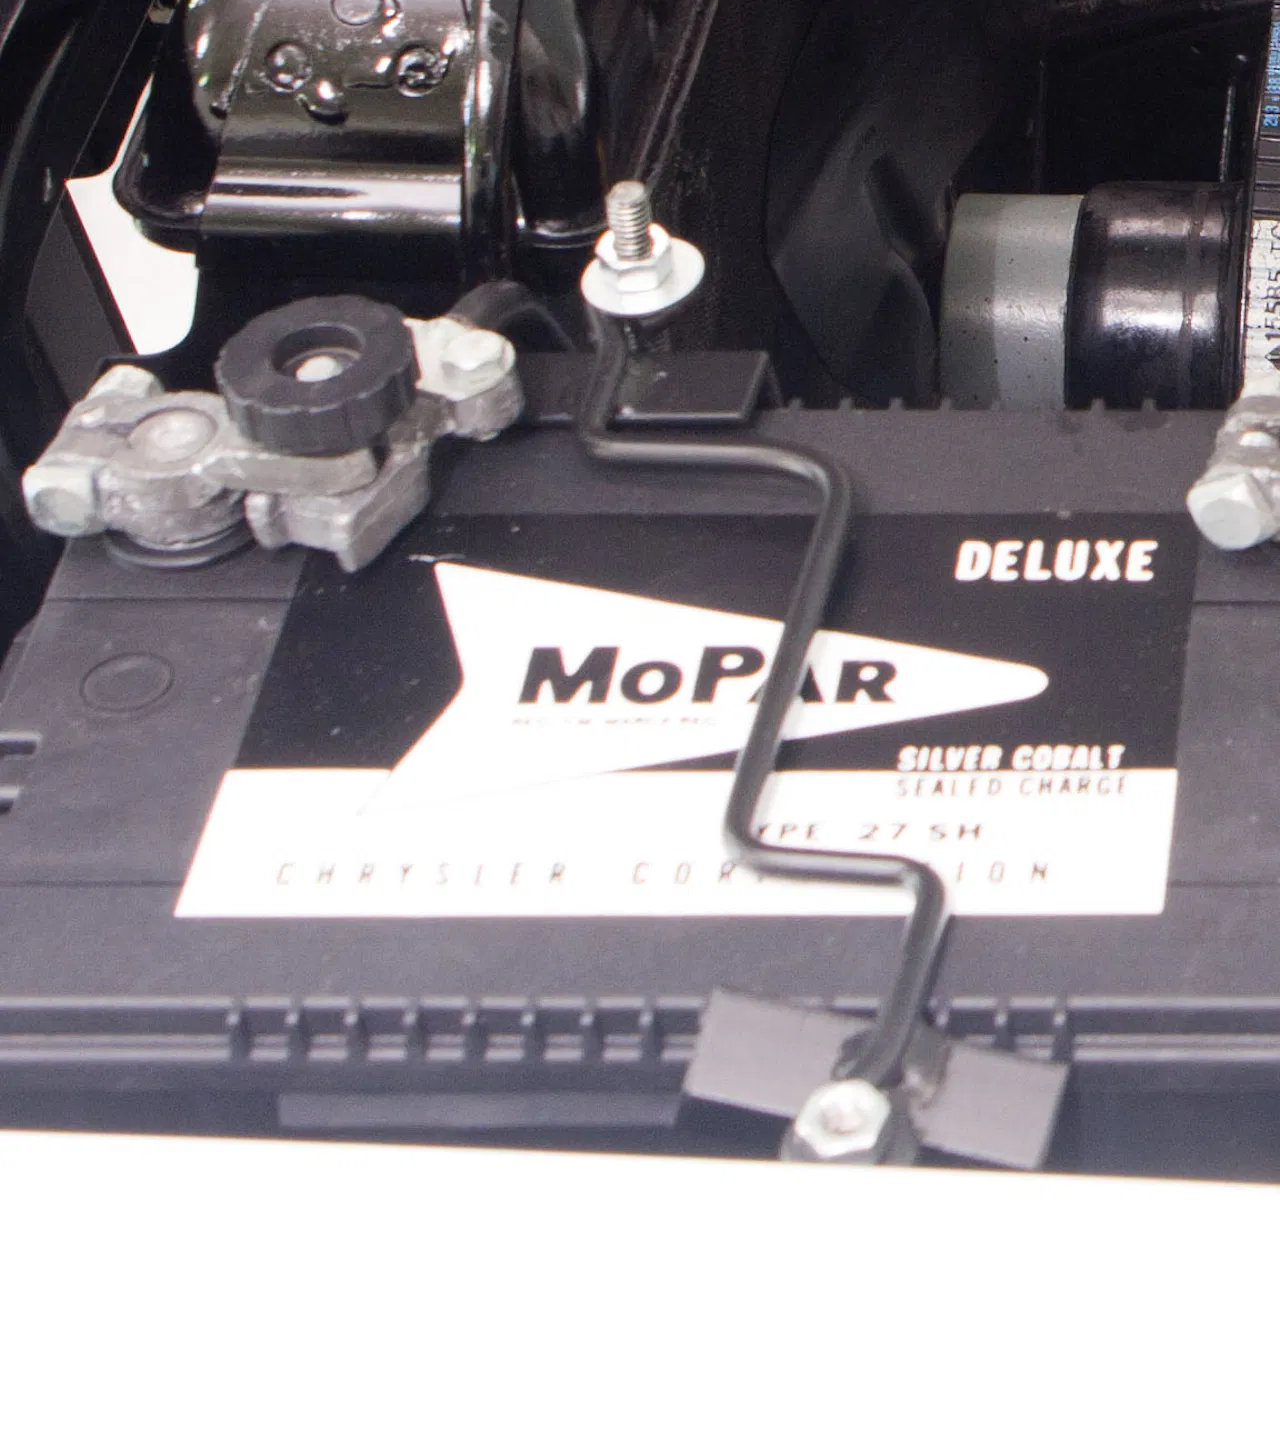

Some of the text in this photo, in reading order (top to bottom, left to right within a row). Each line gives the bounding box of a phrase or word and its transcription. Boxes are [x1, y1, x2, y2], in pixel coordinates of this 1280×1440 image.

[954, 538, 1160, 583] DELUXE
[897, 743, 1127, 772] SILVER COBALT
[896, 775, 1128, 798] SEALED CHARGE
[754, 822, 983, 842] YPE 27 SH
[275, 860, 1050, 887] CHRYSLER CORION
